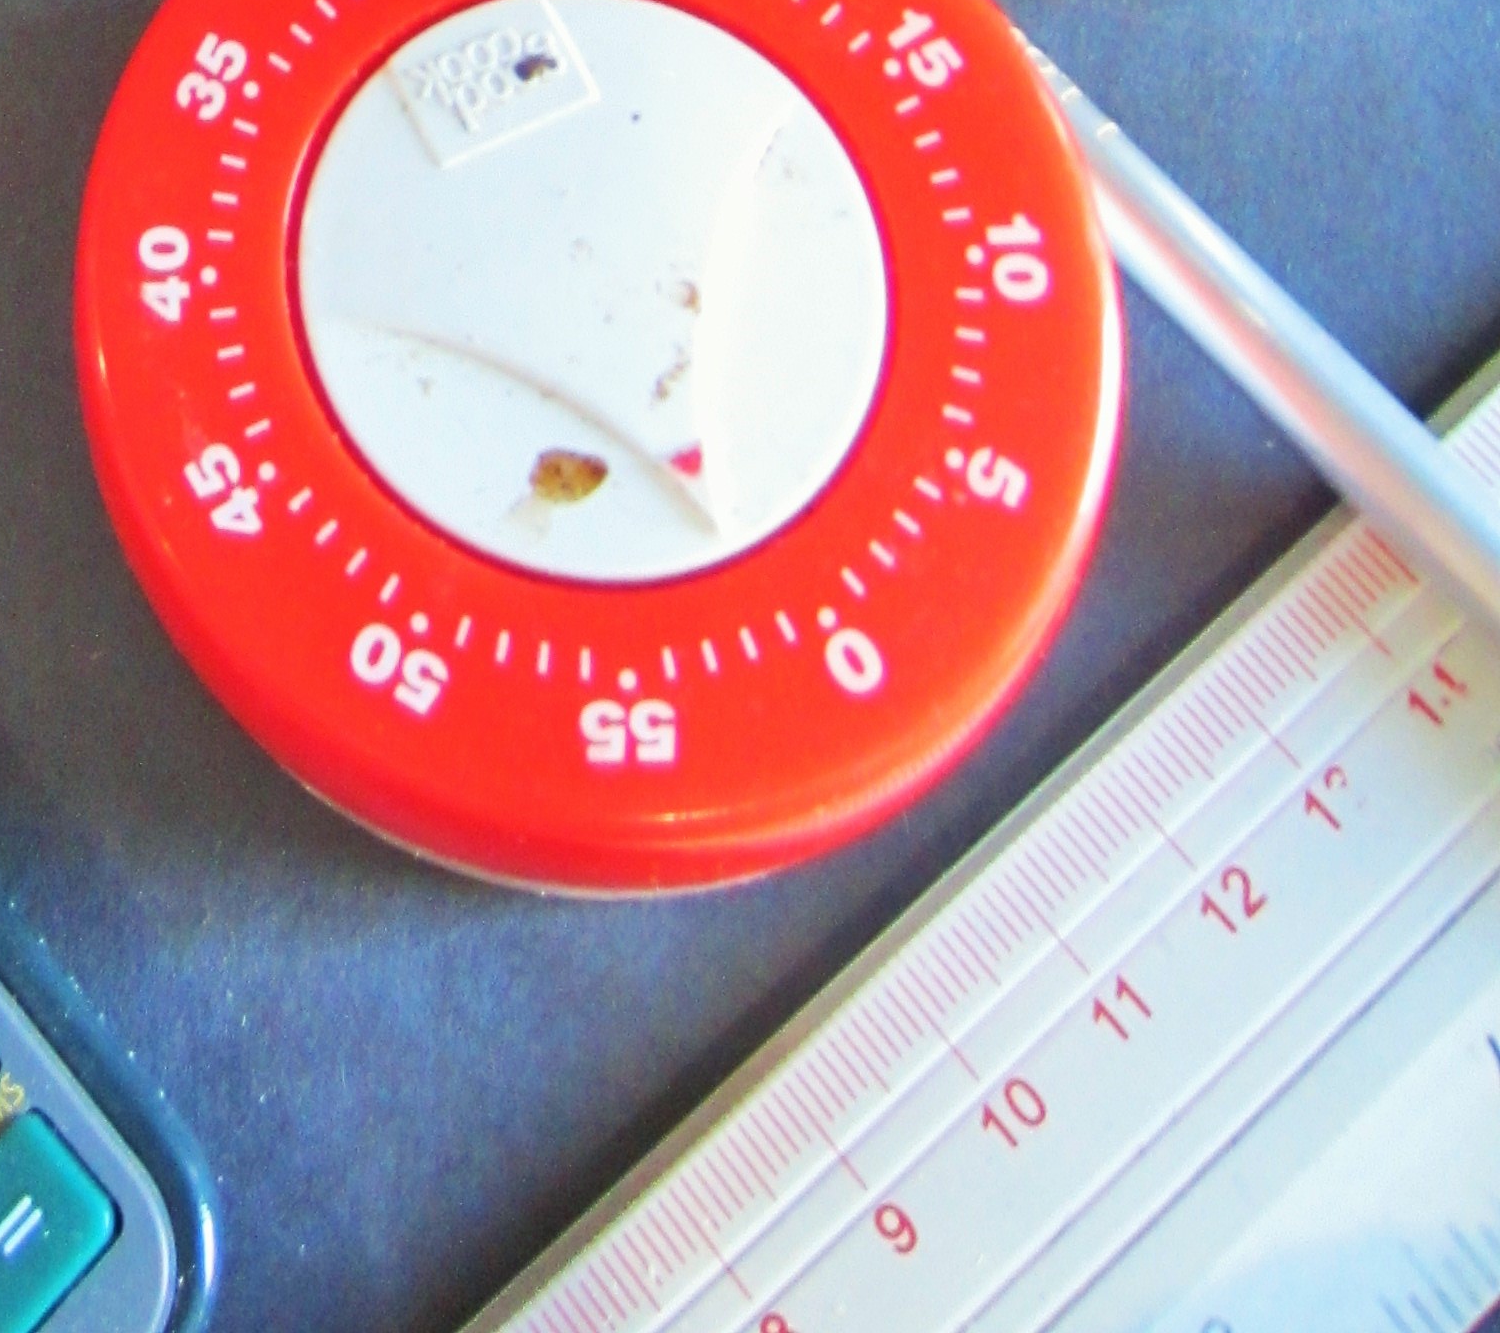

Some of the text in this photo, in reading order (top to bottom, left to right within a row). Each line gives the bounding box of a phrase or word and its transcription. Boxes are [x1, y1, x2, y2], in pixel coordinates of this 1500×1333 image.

[175, 31, 249, 122] 35
[887, 8, 964, 88] 15
[137, 226, 191, 322] 40
[985, 213, 1049, 302] 10
[183, 441, 262, 539] 45
[964, 445, 1029, 511] 5
[348, 620, 451, 716] 50
[823, 626, 886, 695] 0
[578, 698, 677, 765] 55
[1200, 866, 1268, 934] 12
[1092, 974, 1152, 1040] 11
[981, 1077, 1047, 1147] 10
[874, 1202, 919, 1255] 9
